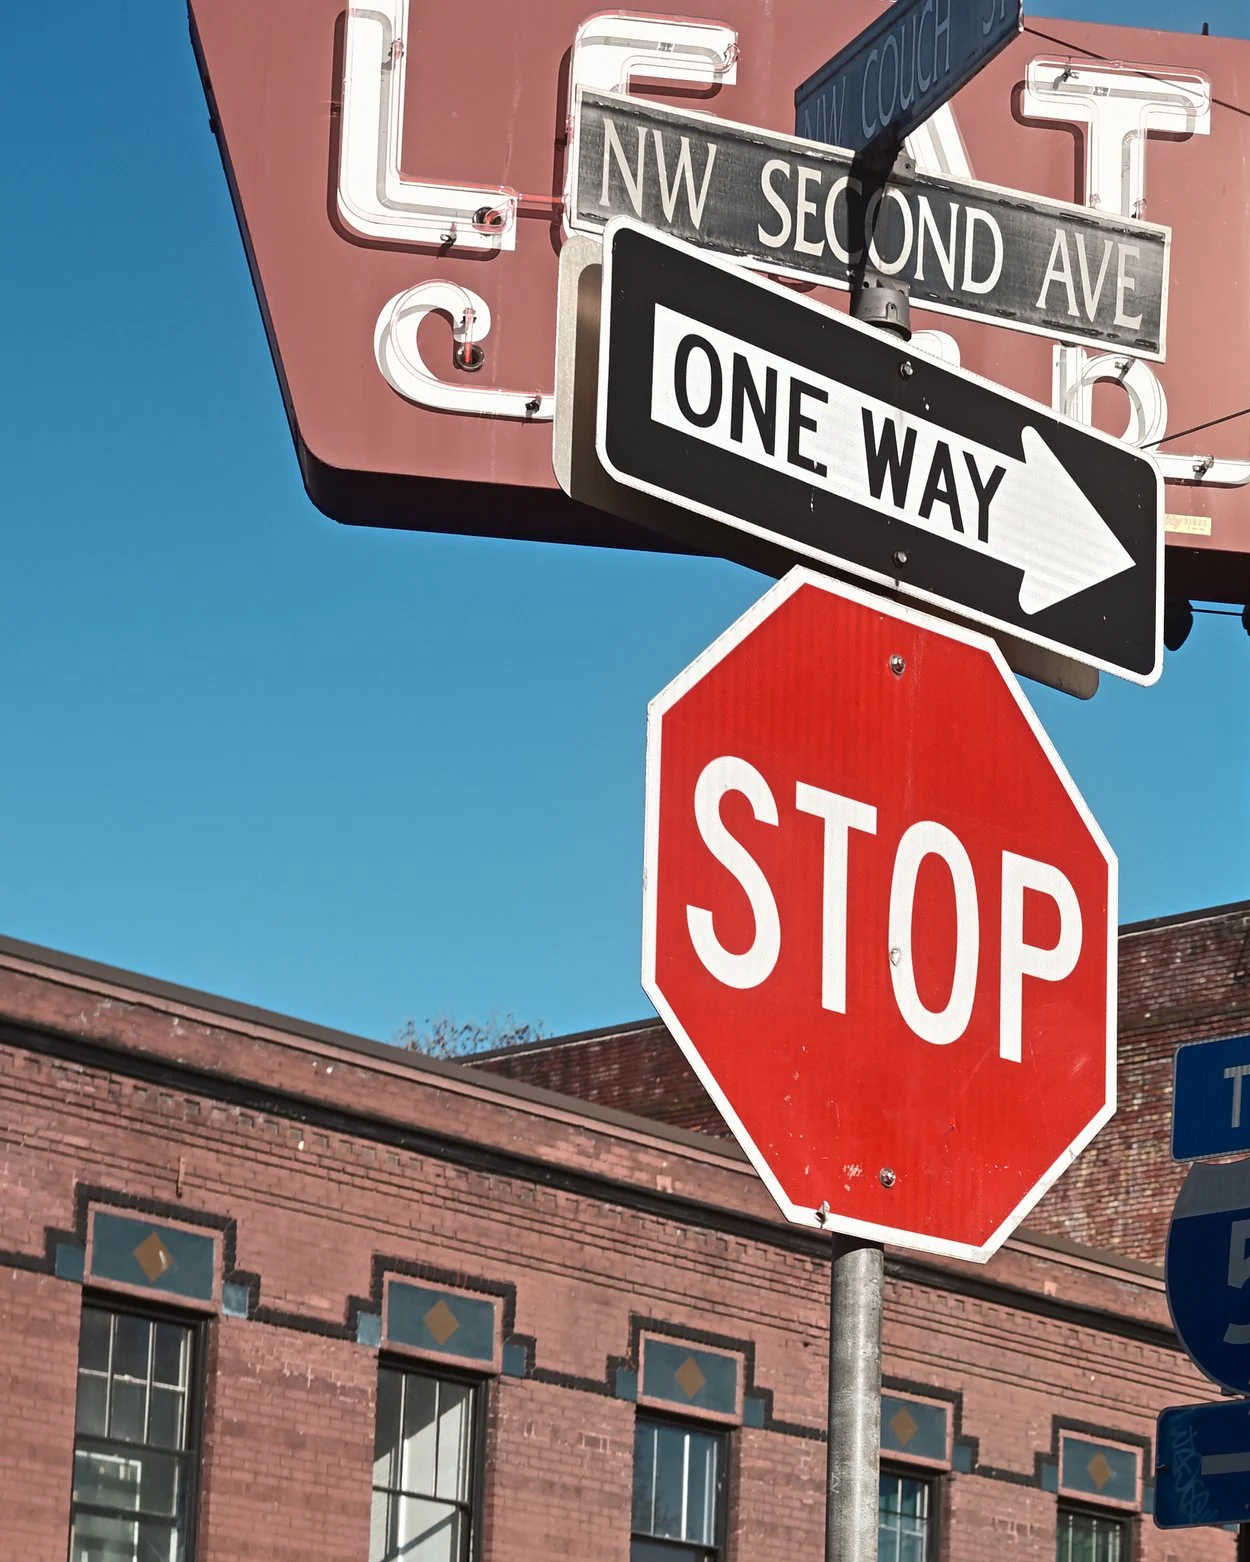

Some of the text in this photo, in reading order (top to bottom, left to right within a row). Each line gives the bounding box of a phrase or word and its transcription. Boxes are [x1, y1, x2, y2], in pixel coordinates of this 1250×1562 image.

[862, 0, 951, 139] COUCH
[599, 118, 1143, 329] NW SECOND AVE
[674, 332, 1007, 543] ONE WAY
[685, 755, 1084, 1064] STOP
